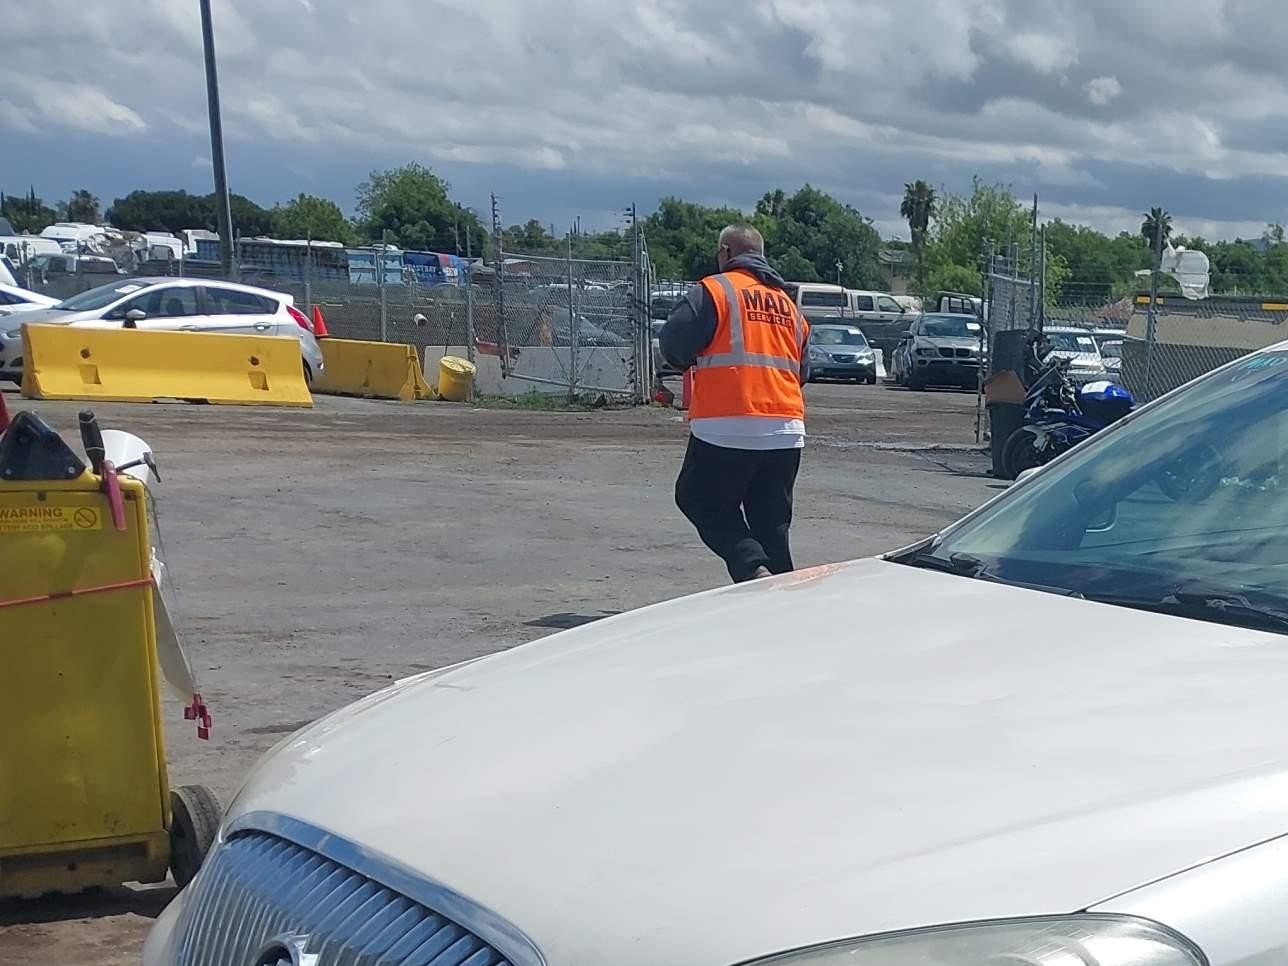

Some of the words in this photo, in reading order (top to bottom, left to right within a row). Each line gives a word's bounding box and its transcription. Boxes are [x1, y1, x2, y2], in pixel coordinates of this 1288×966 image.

[741, 289, 791, 317] MAD
[750, 313, 792, 326] SERVICES
[0, 508, 63, 519] WARNING
